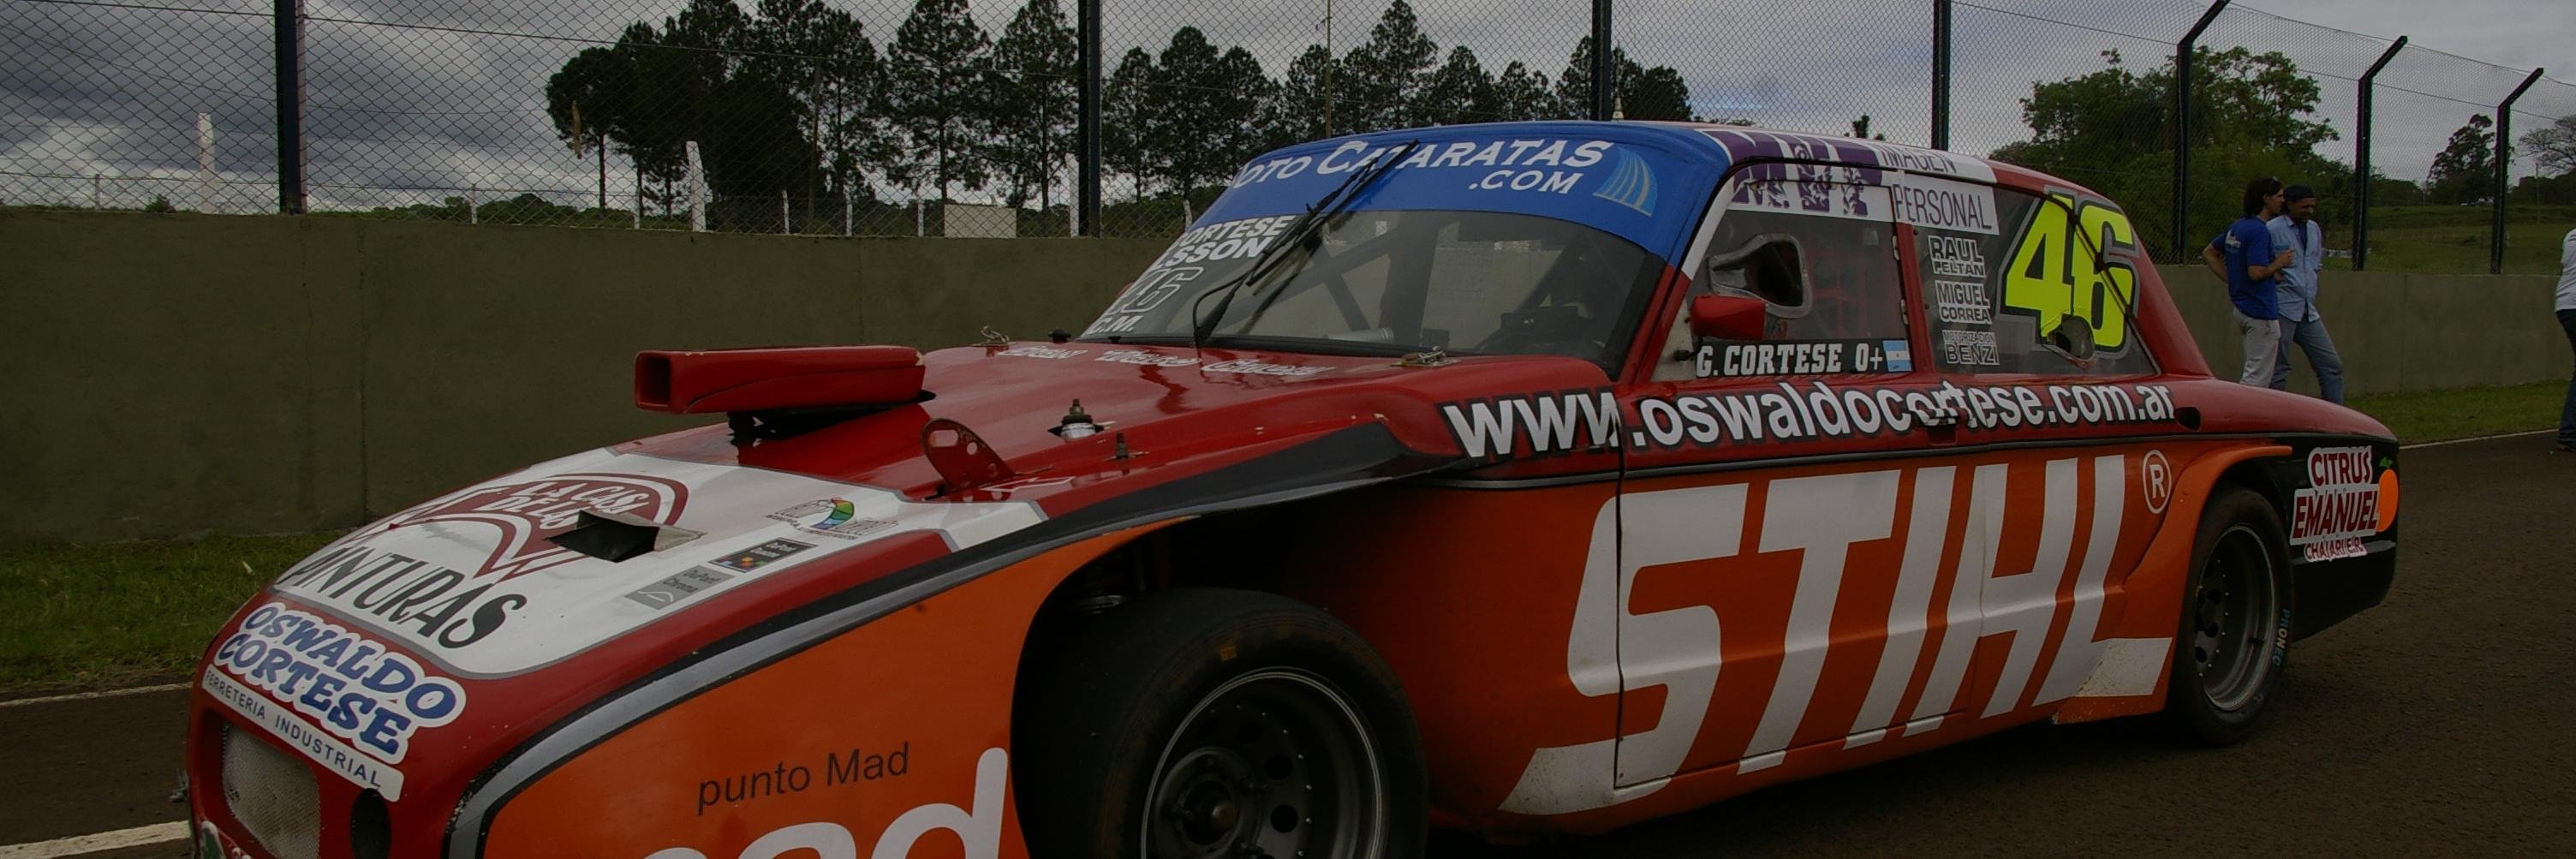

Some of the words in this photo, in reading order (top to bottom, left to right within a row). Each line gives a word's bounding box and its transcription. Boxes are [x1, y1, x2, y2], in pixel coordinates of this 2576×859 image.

[1233, 156, 1312, 188] OTO
[1469, 170, 1584, 194] .COM
[1892, 183, 1993, 230] PERSONAL
[1178, 214, 1297, 248] ORTESE
[1929, 236, 1983, 263] RAUL
[1156, 236, 1274, 269] SSON
[2002, 190, 2137, 351] 46
[1935, 282, 1990, 307] MIGUEL
[1941, 306, 1991, 323] CORREA
[2311, 450, 2372, 486] CITRUS
[2292, 489, 2378, 539] EMANUEL
[1498, 454, 2174, 816] STIHL
[245, 606, 457, 719] OSWALDO
[218, 634, 411, 755] CORTESE
[206, 669, 266, 720] FERRETERIA
[275, 714, 382, 788] INDUSTRIAL
[697, 760, 812, 816] punto
[826, 741, 909, 787] Mad
